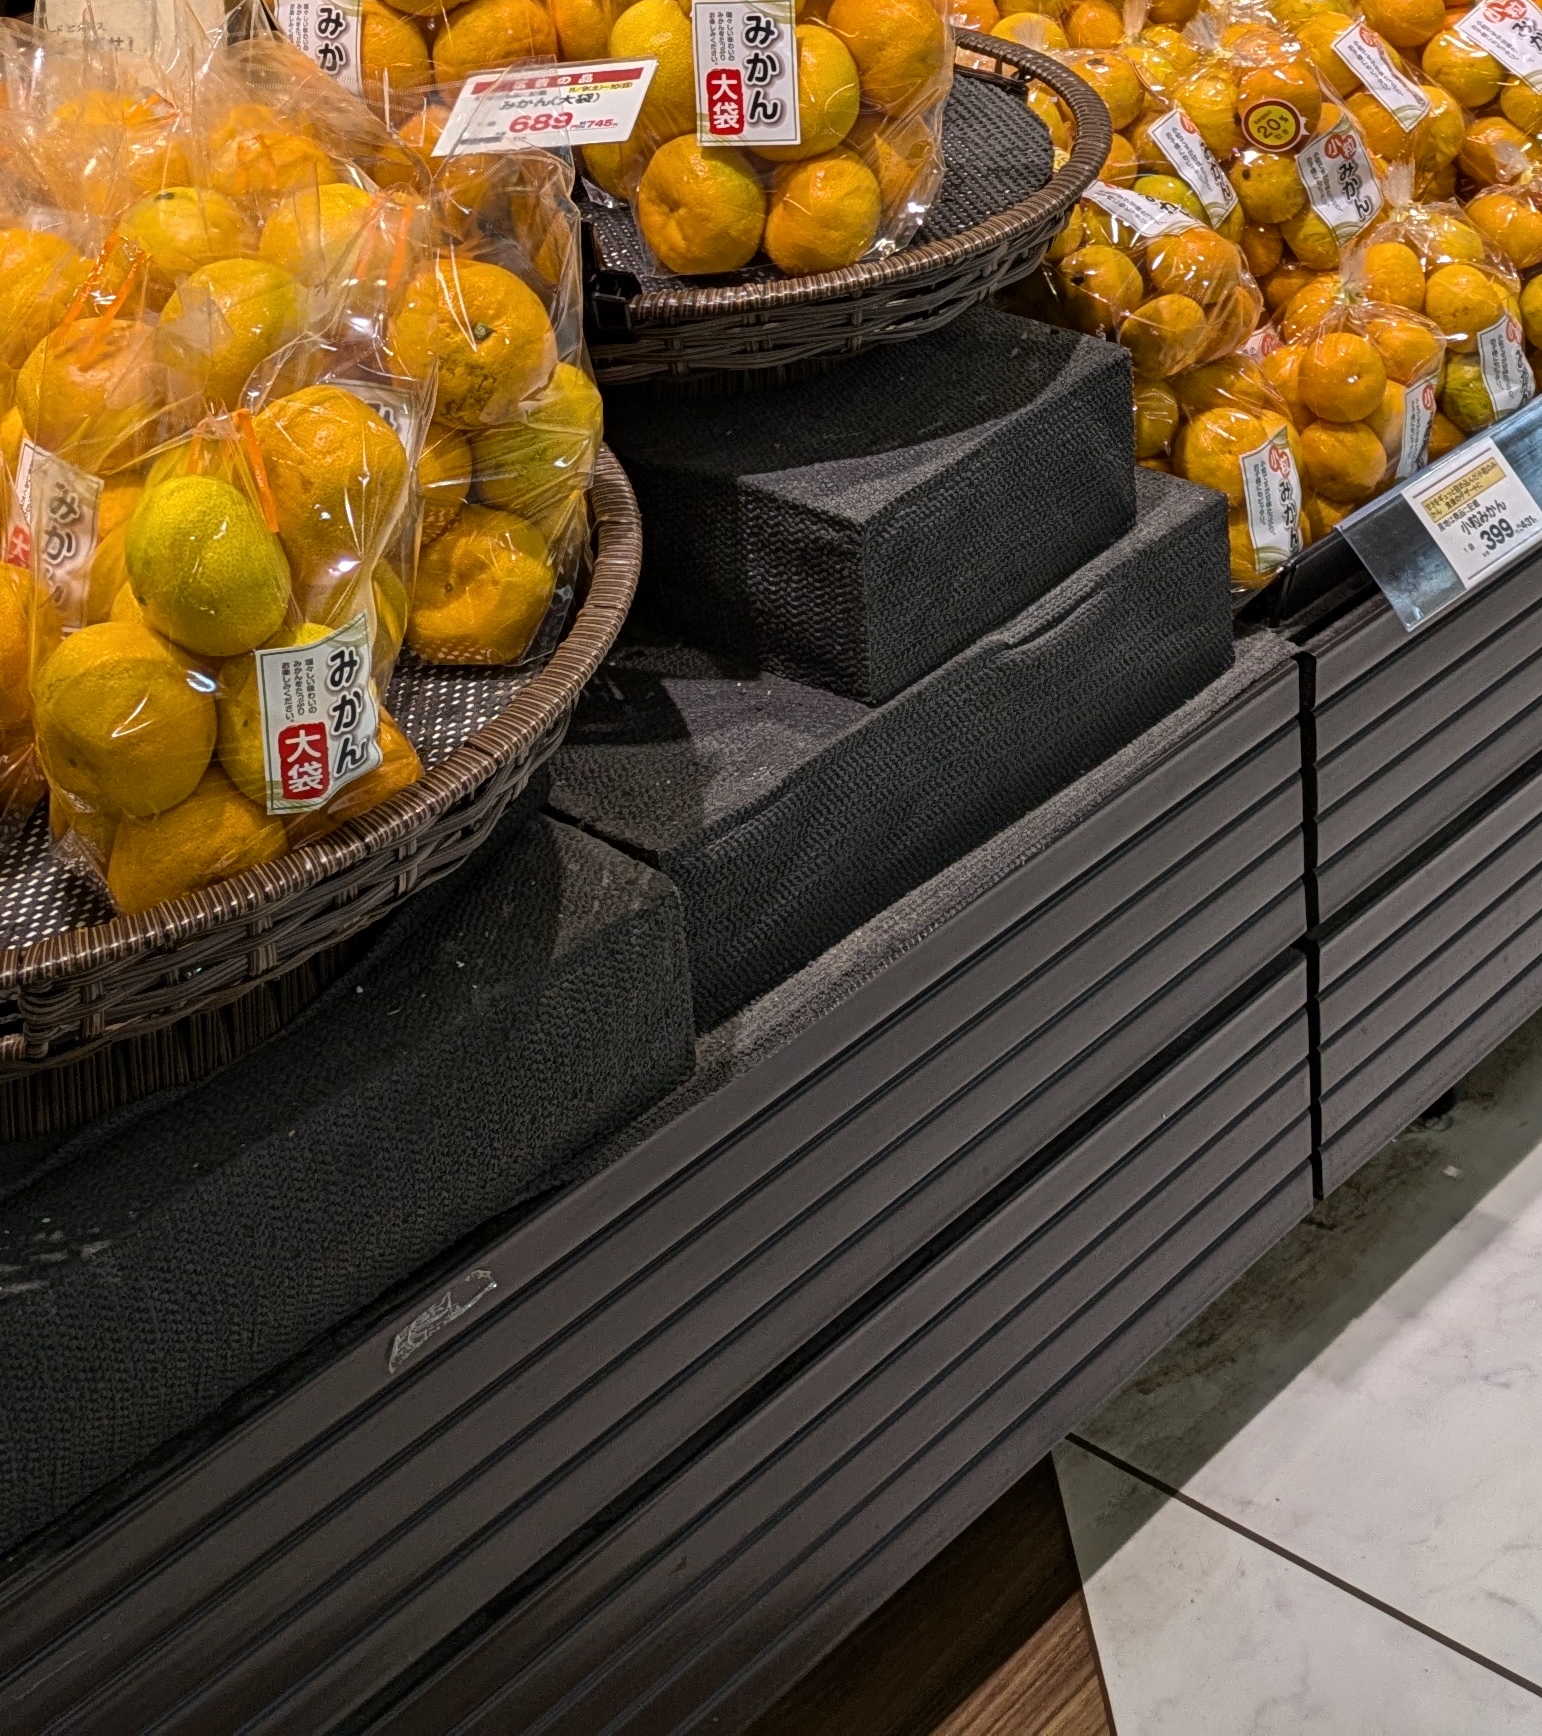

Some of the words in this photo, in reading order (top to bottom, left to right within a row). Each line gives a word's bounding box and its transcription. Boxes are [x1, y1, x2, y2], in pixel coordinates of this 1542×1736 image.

[514, 72, 594, 93] 広告の品
[743, 12, 781, 123] みかん
[499, 91, 601, 112] みかん(大袋)
[508, 111, 574, 134] 689
[711, 73, 741, 131] 大袋
[1324, 133, 1358, 160] 小粒
[1337, 161, 1372, 221] みかん
[1279, 478, 1301, 554] みかん
[1459, 498, 1508, 534] 小粒みかん
[1478, 516, 1516, 553] 399
[326, 646, 371, 774] みかん
[284, 728, 325, 796] 大袋
